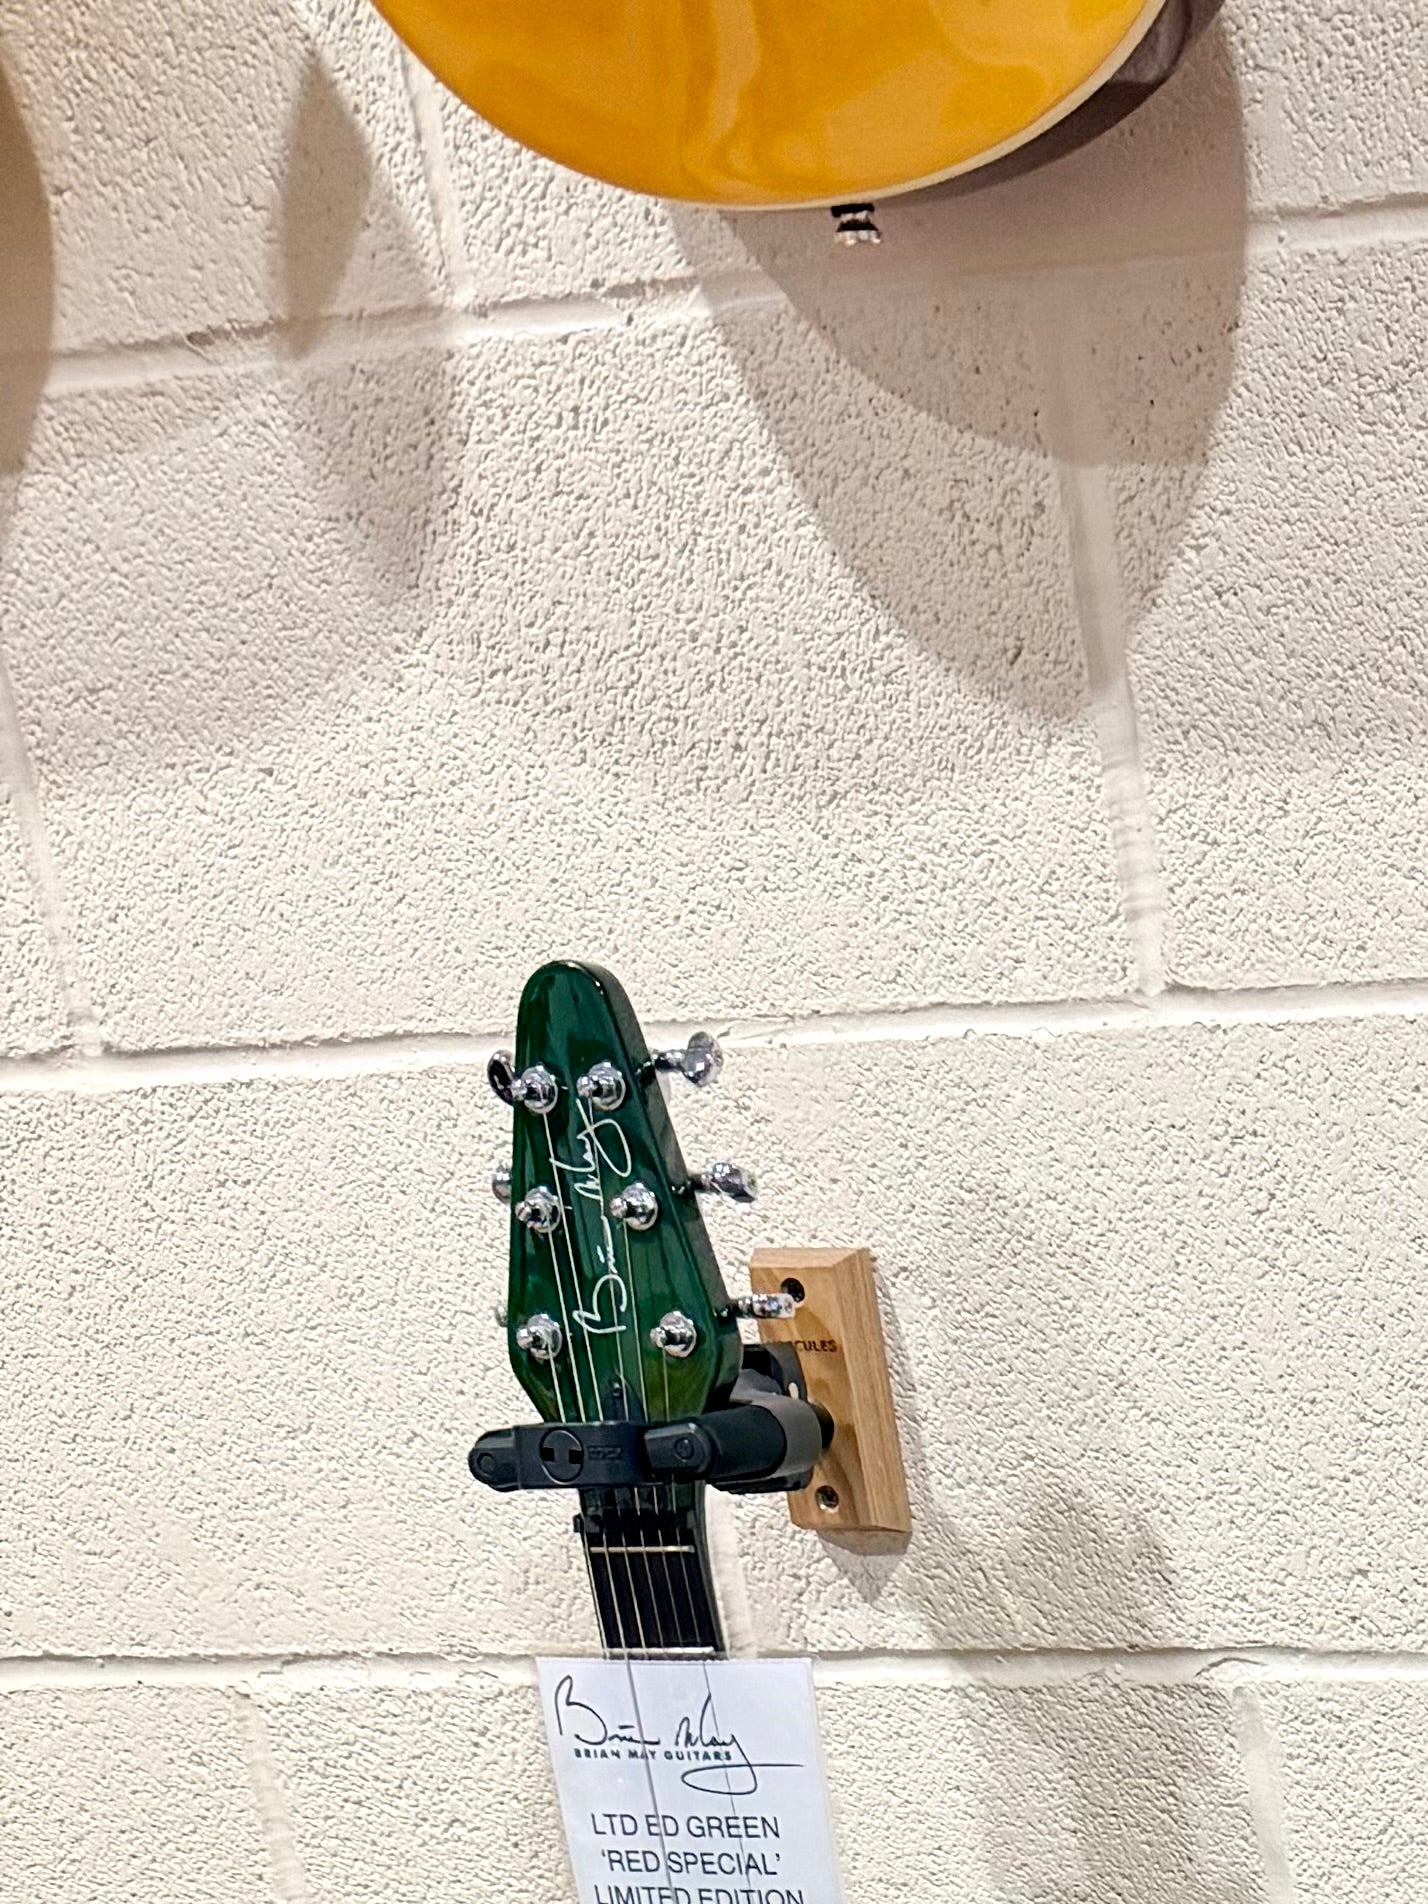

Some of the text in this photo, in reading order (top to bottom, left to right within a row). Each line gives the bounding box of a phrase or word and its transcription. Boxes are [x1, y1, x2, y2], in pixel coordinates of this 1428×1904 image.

[575, 1749, 732, 1761] BRIAN MAY GUITARS
[590, 1813, 781, 1839] LTD ED GREEN
[600, 1849, 782, 1877] ‘RED SPECIAL’
